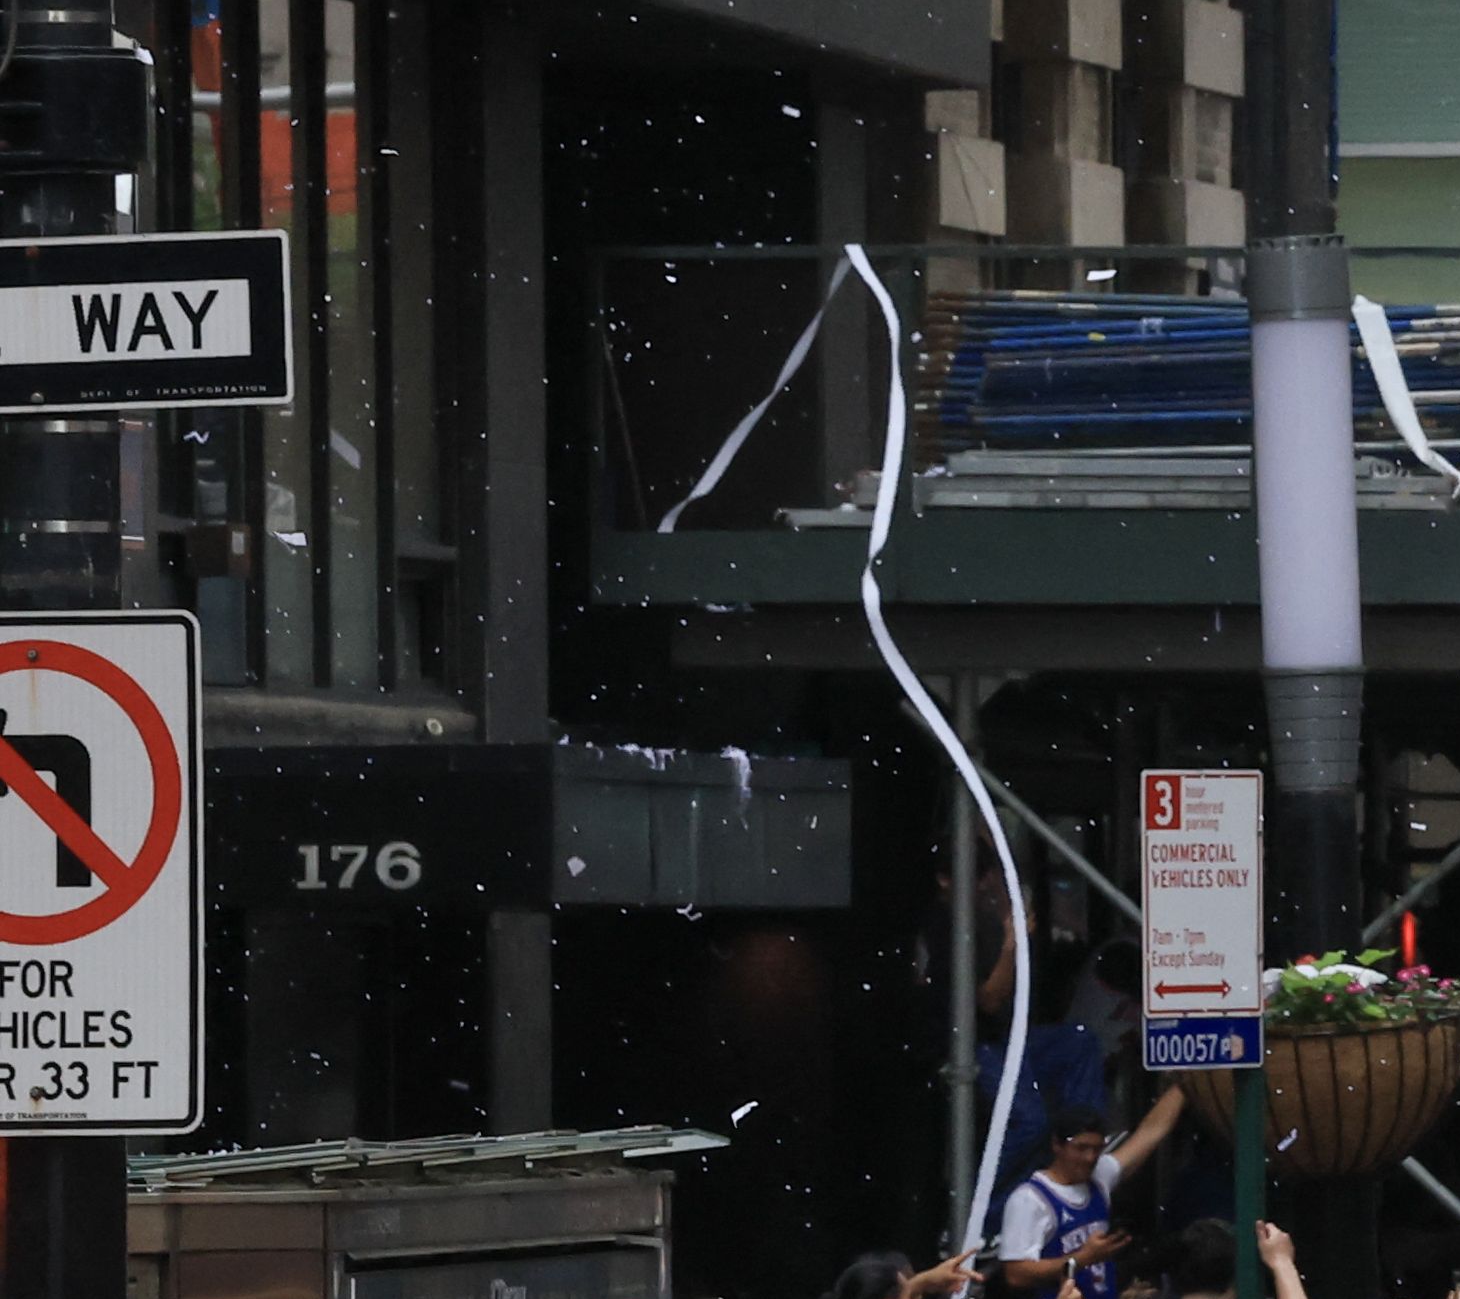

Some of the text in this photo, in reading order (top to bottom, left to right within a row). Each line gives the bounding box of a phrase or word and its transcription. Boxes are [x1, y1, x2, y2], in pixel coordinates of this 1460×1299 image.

[71, 289, 219, 354] WAY
[1154, 780, 1174, 826] 3
[295, 842, 423, 890] 176
[1151, 843, 1237, 863] COMMERCIAL
[1152, 869, 1249, 889] VEHICLES ONLY
[1152, 928, 1173, 945] 7am
[1183, 928, 1206, 948] 7pm
[1152, 951, 1226, 970] Except Sunday
[0, 960, 73, 999] FOR
[1149, 1033, 1219, 1063] 100057
[41, 1061, 89, 1100] 33
[112, 1060, 159, 1099] FT
